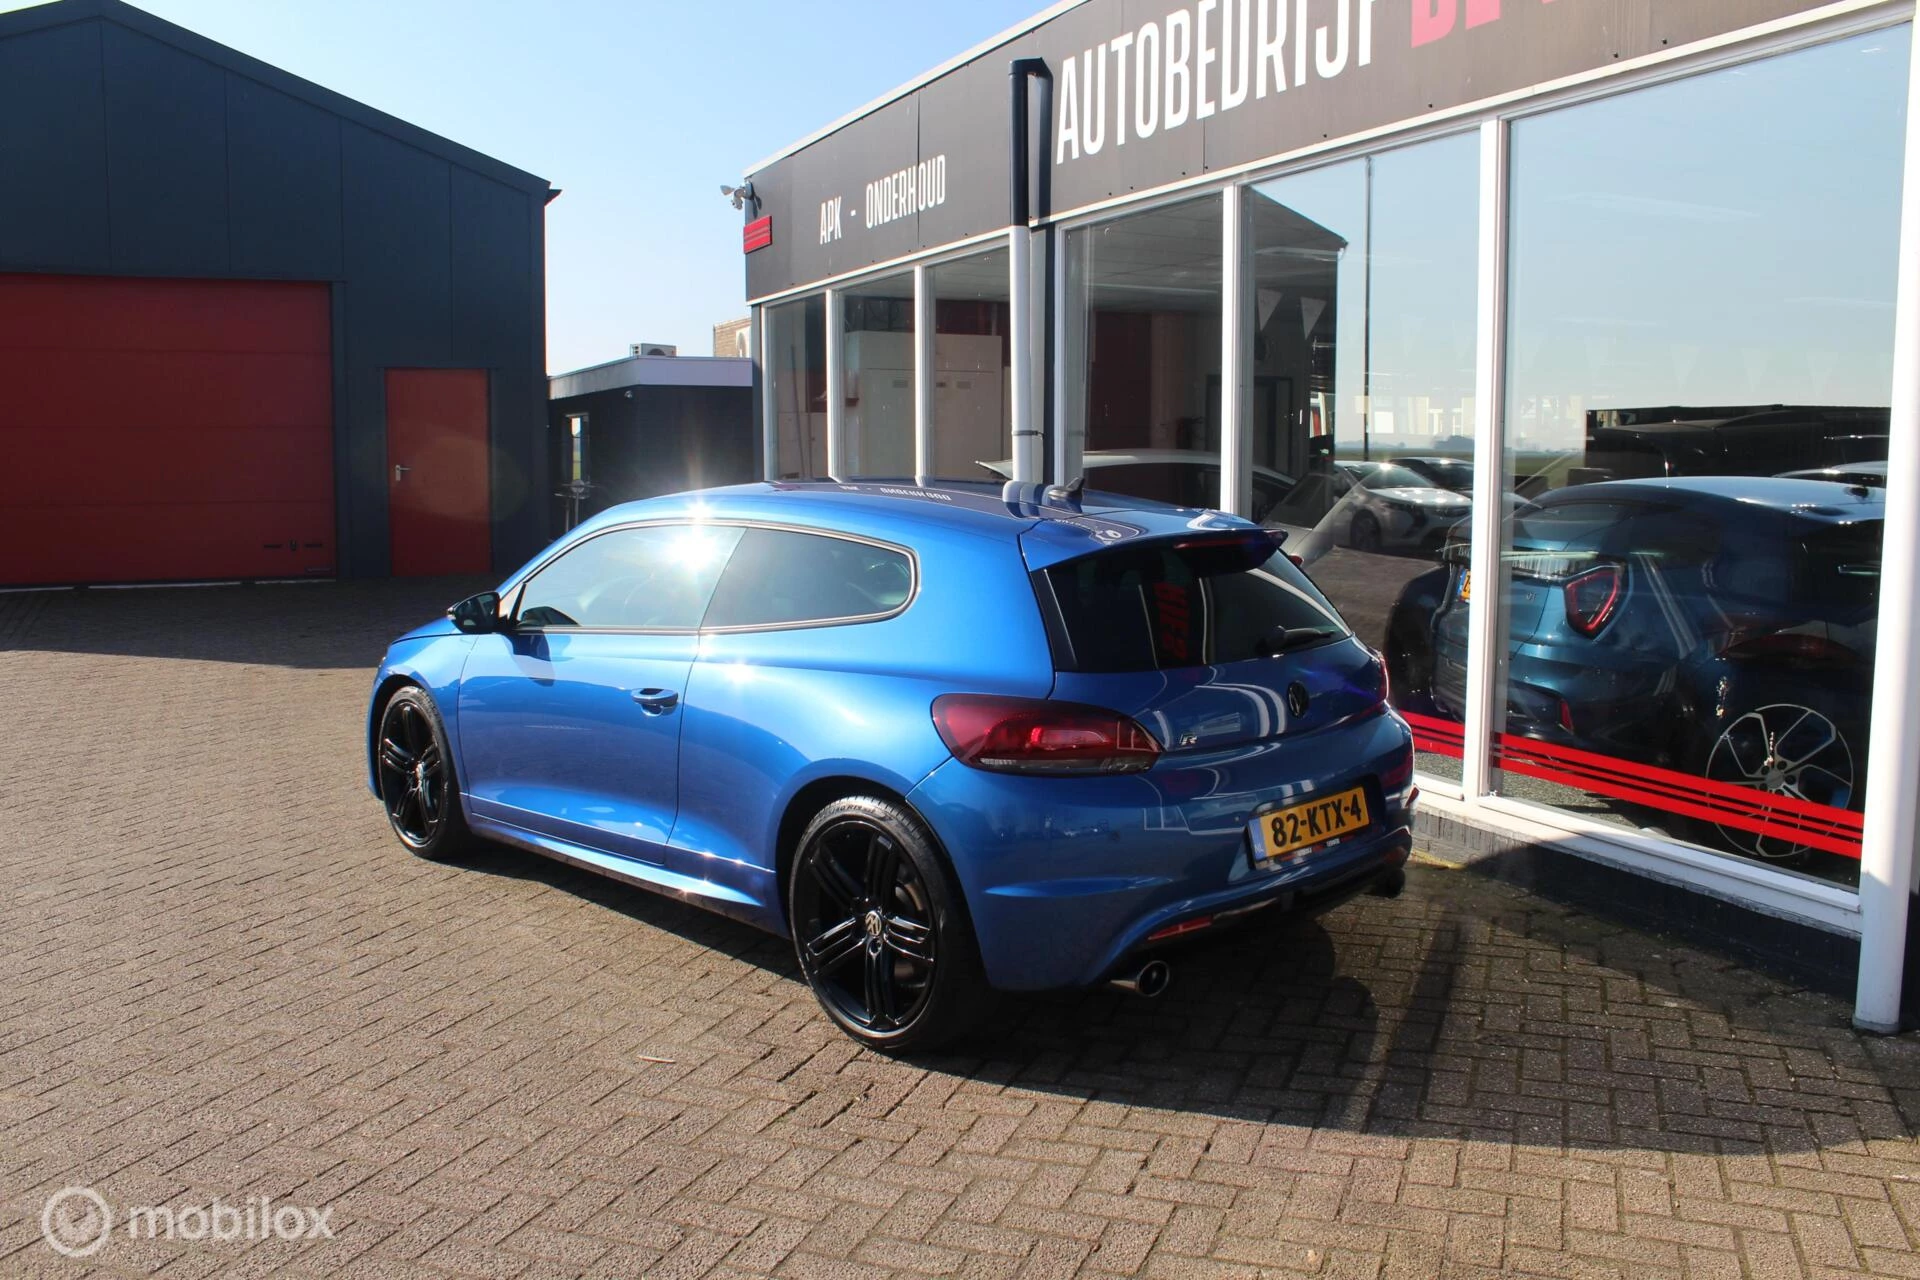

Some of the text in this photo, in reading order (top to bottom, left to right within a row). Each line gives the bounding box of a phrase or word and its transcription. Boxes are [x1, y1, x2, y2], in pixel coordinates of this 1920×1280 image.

[820, 196, 842, 245] APK
[866, 154, 946, 229] ONDERHOUD
[1271, 793, 1362, 848] 82-KTX-4
